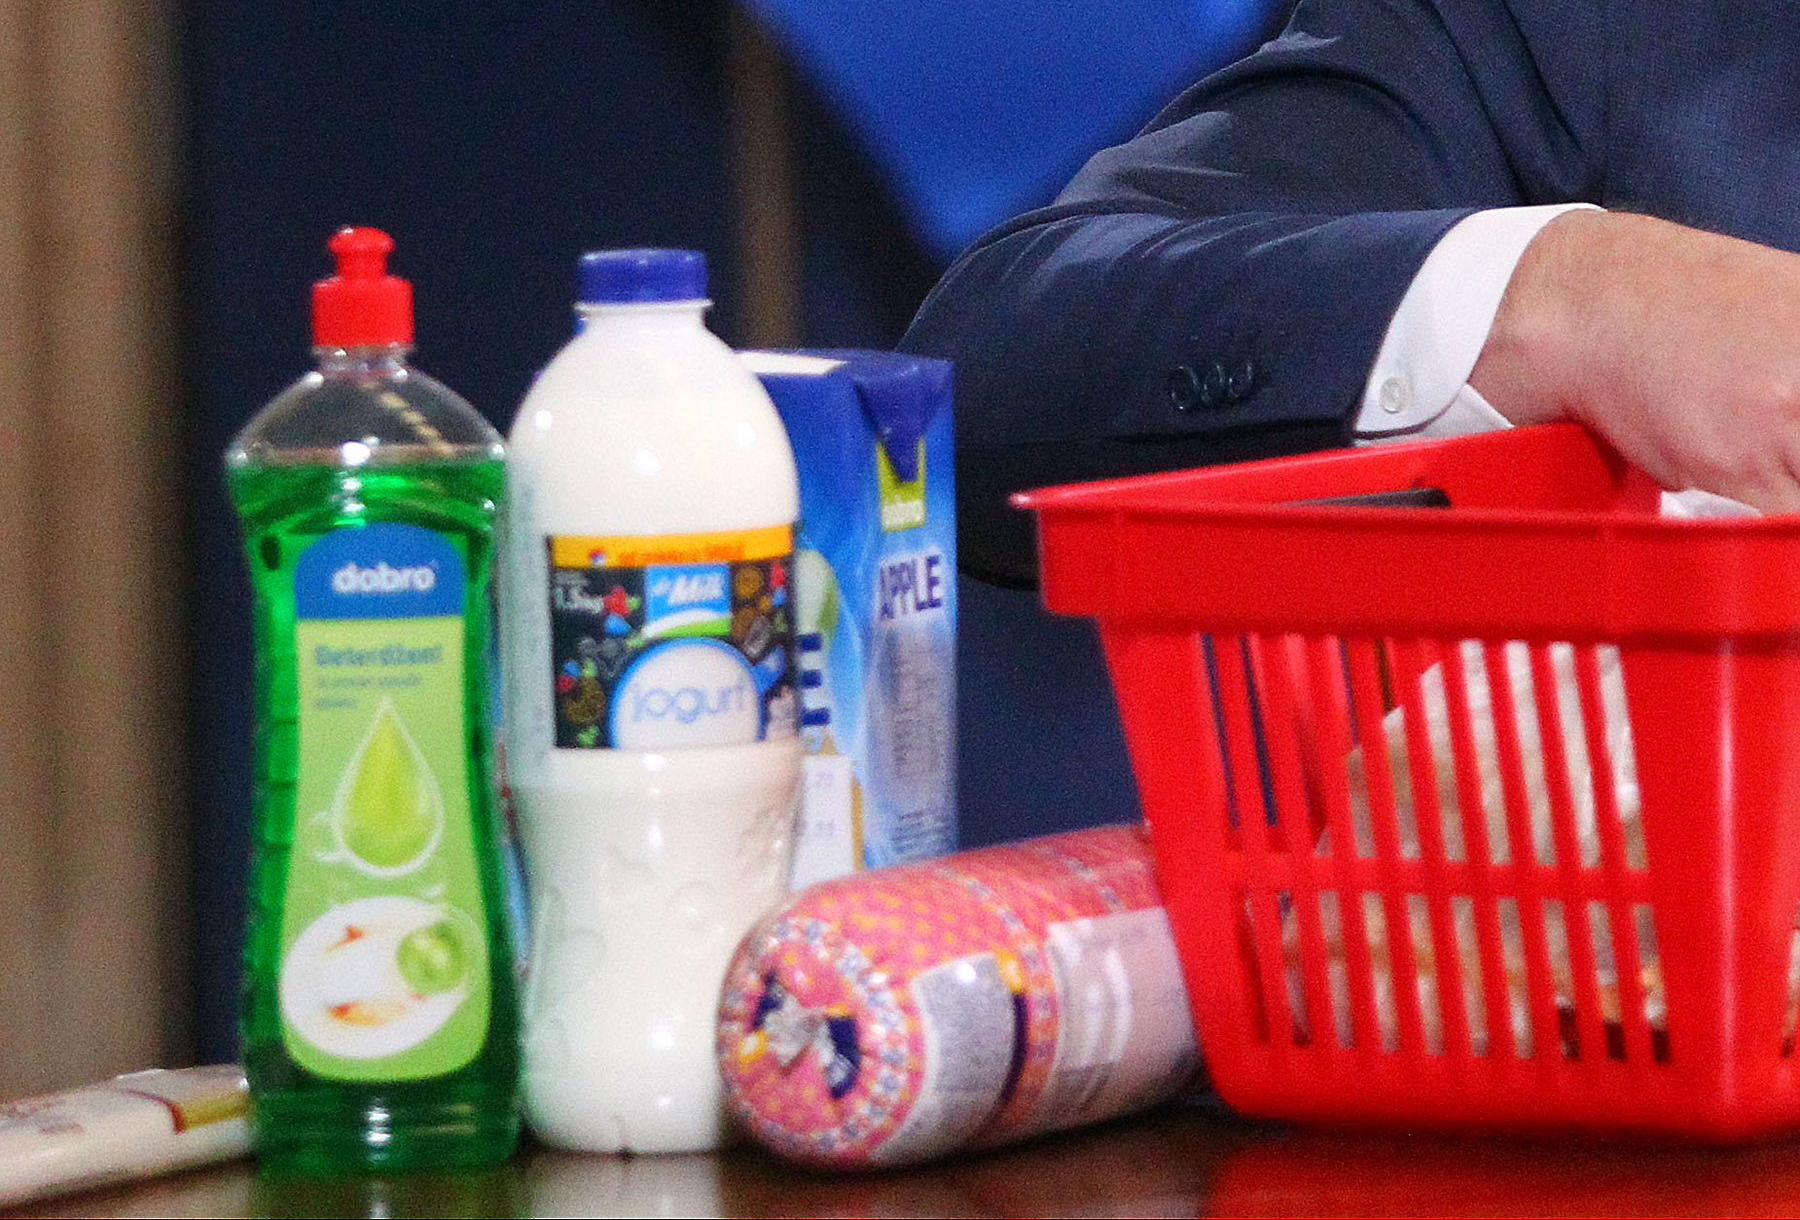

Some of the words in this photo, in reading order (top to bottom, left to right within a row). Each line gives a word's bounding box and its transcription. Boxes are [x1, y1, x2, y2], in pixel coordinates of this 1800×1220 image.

[331, 560, 436, 594] dobro
[880, 555, 942, 620] APPLE
[632, 677, 746, 725] jogurt
